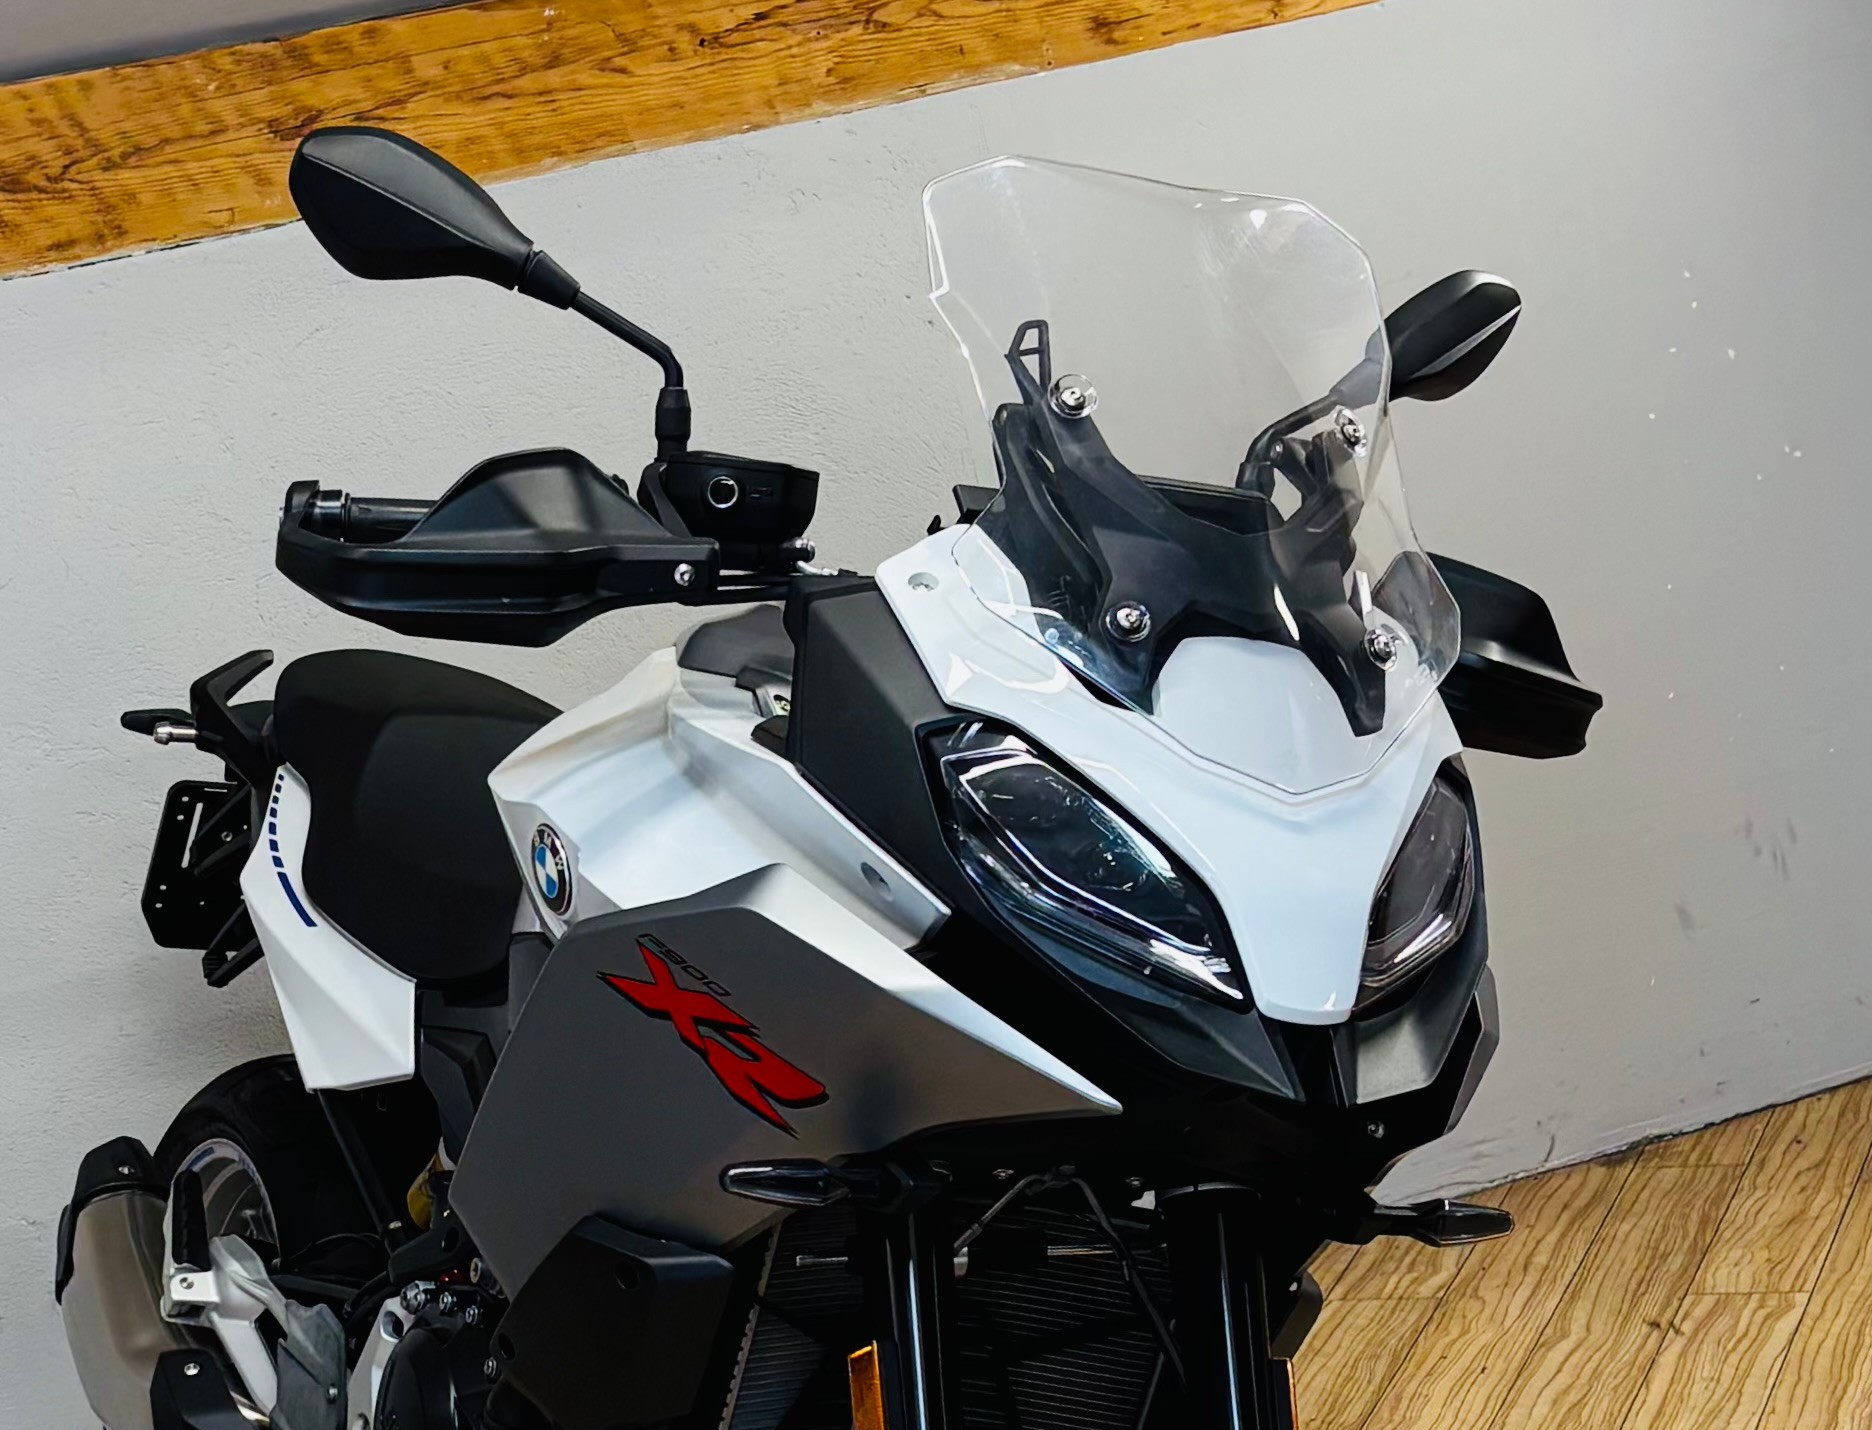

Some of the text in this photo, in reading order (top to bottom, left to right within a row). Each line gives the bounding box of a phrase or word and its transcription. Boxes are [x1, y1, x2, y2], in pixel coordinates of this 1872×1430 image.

[533, 830, 565, 870] BMW
[636, 933, 732, 997] F900
[596, 938, 834, 1141] XR
